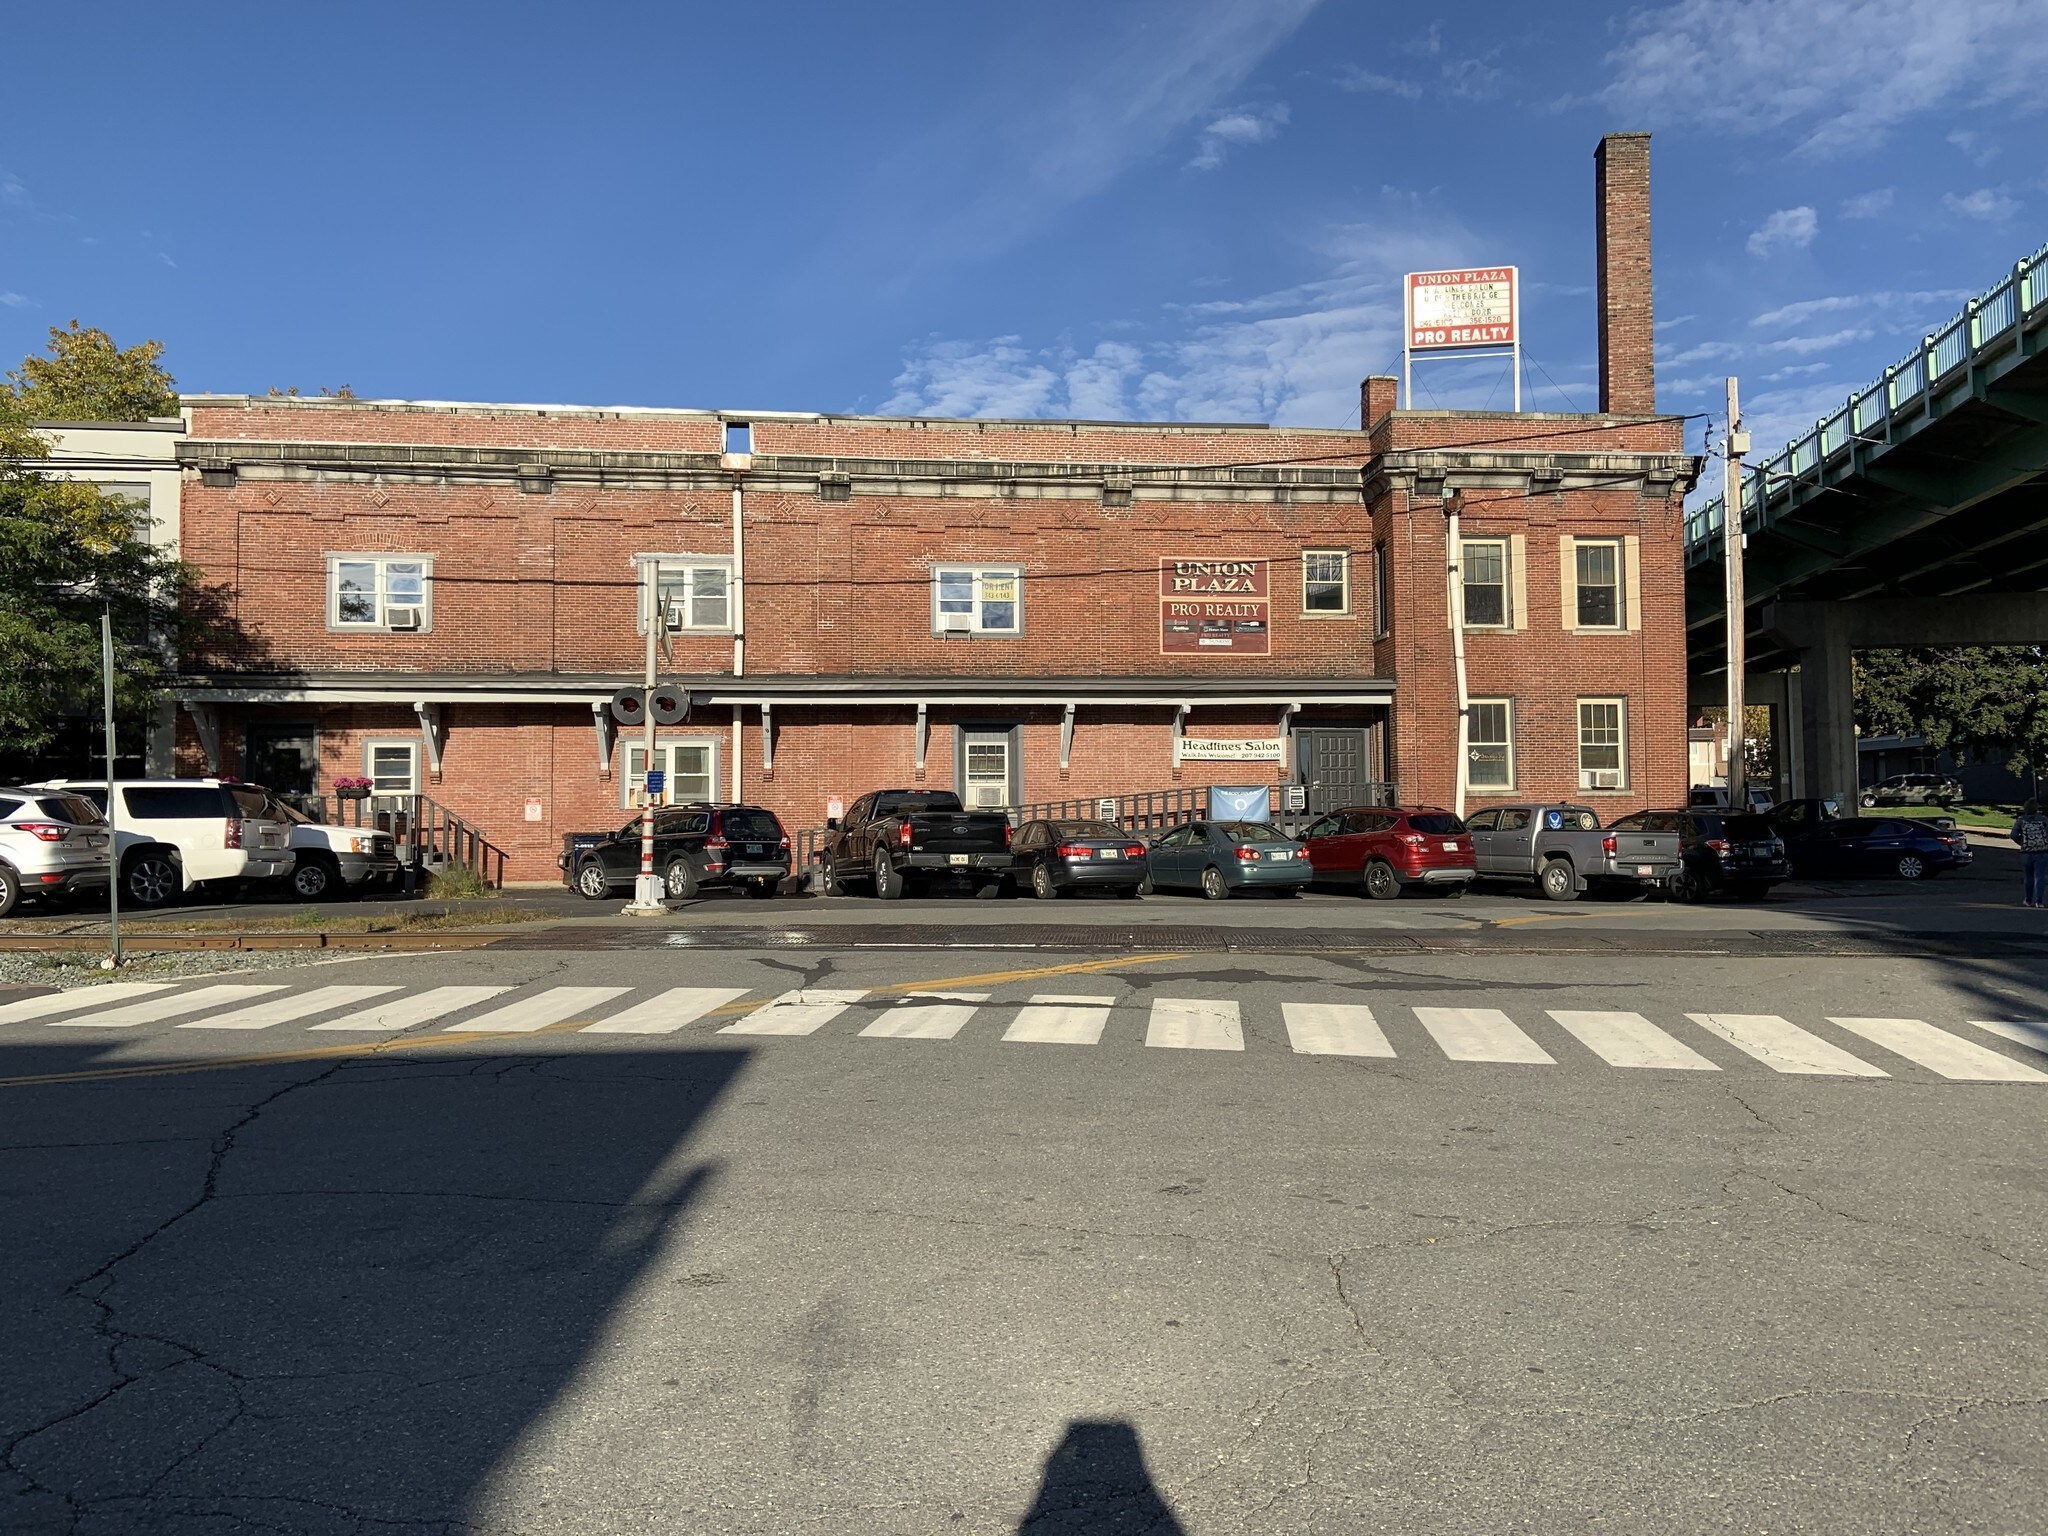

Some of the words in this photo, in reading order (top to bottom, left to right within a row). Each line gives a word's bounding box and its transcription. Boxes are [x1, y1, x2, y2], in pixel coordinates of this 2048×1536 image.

[1418, 274, 1461, 285] UNION
[1464, 271, 1508, 283] PLAZA
[1415, 331, 1446, 344] PRO
[1451, 327, 1510, 342] REALTY
[1173, 562, 1257, 576] UNION
[1173, 578, 1257, 592] PLAZA
[1170, 603, 1200, 616] PRO
[1205, 604, 1260, 616] REALTY
[1182, 740, 1242, 751] Headlines
[1245, 741, 1281, 751] Salon
